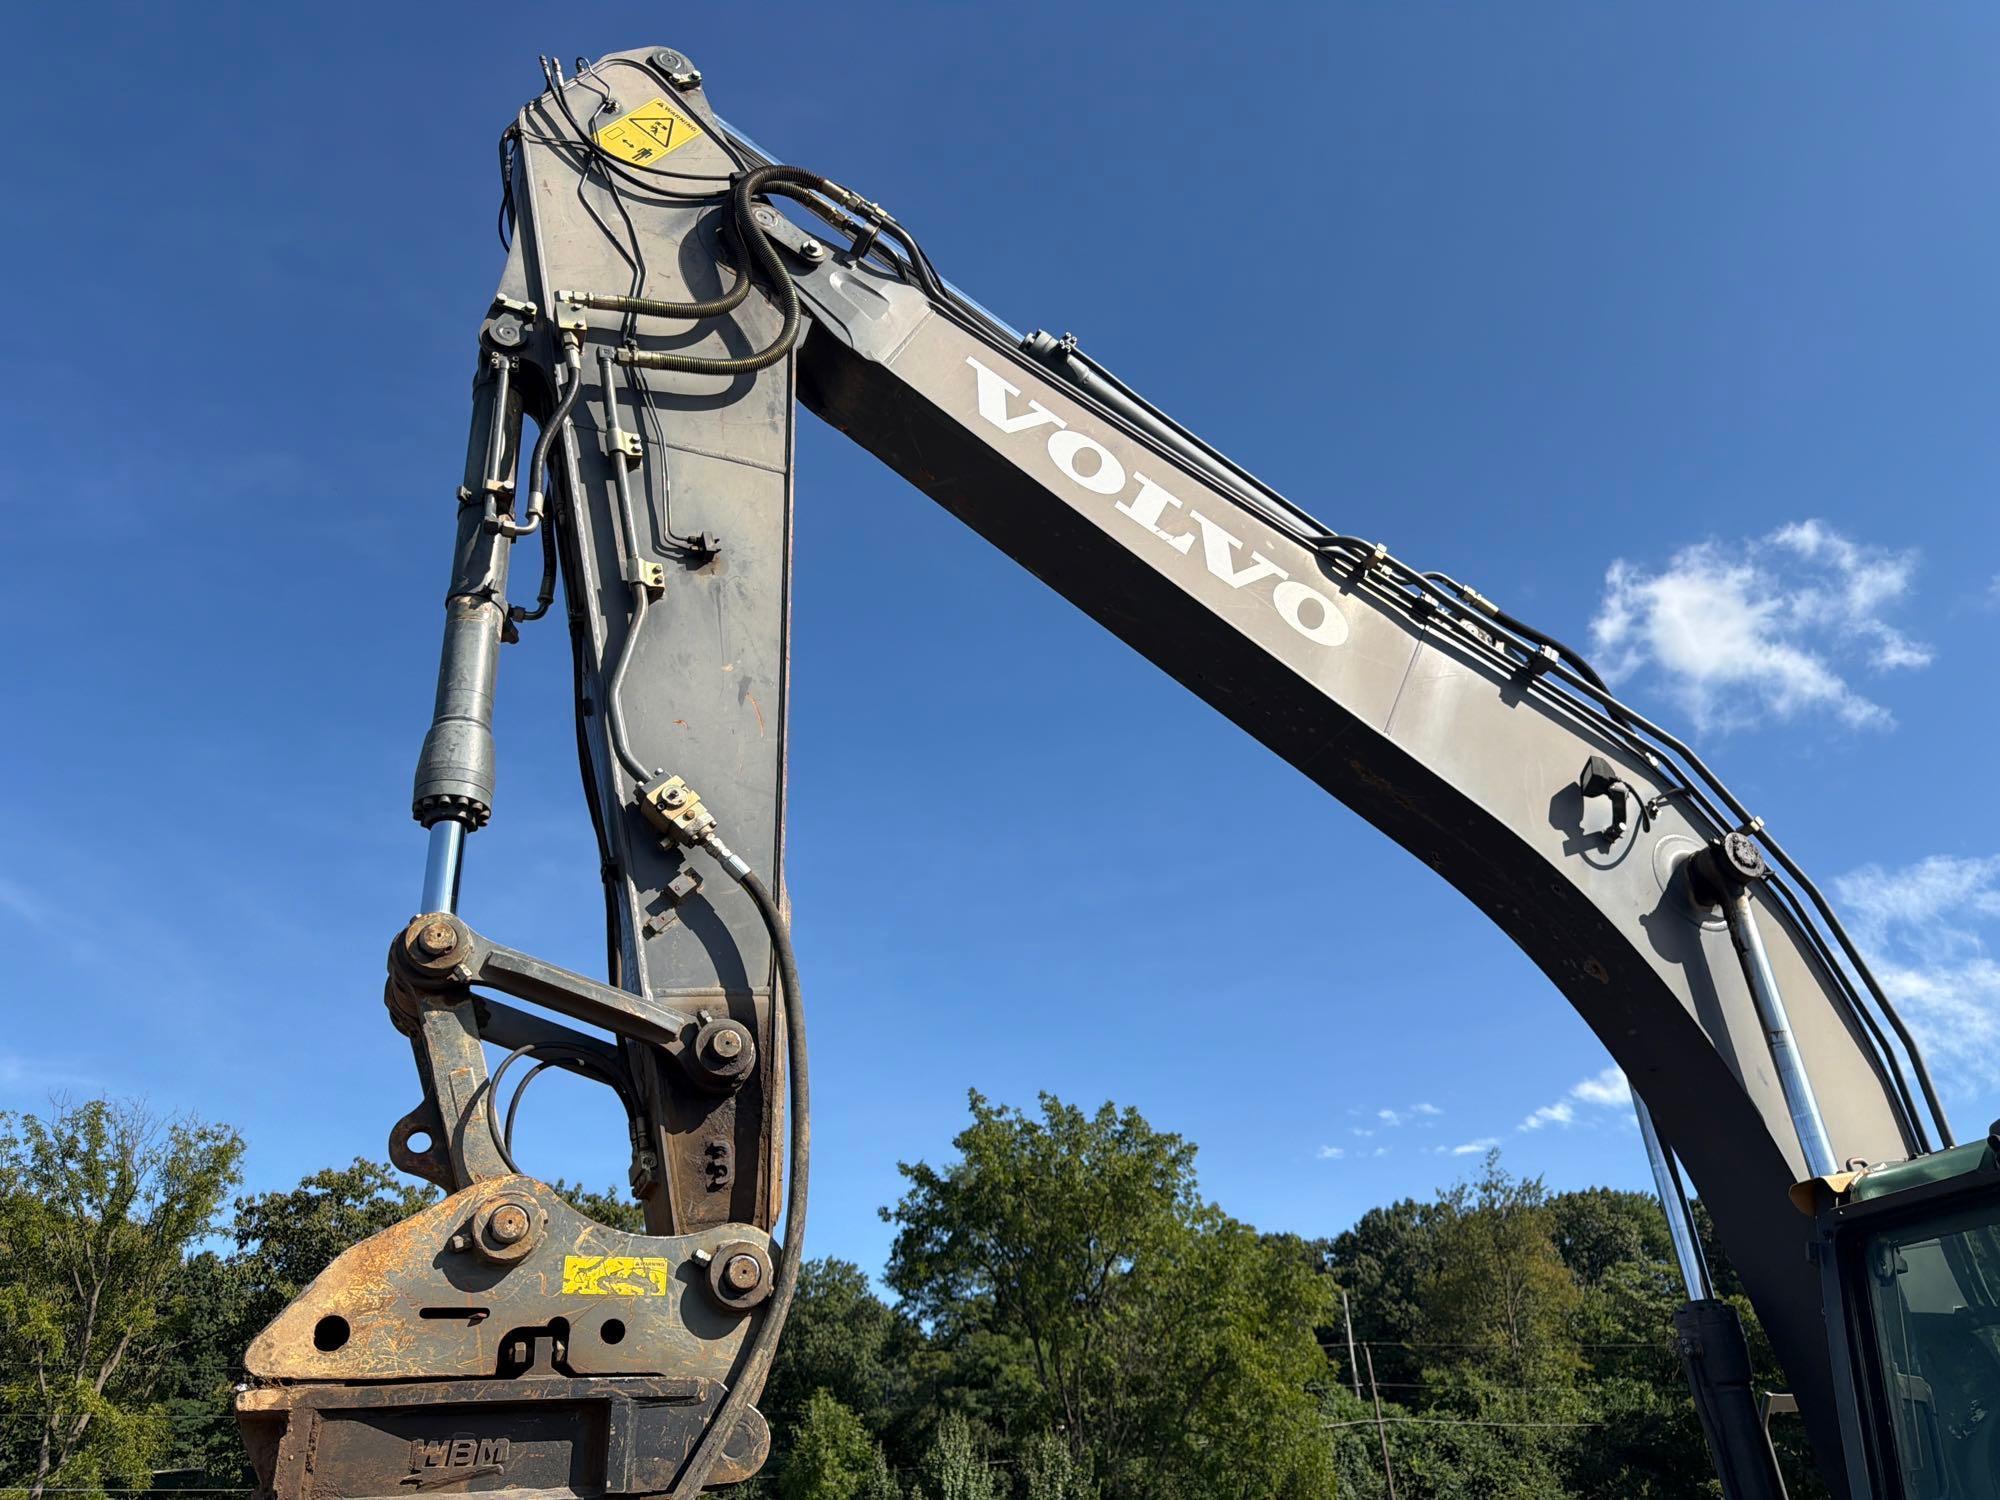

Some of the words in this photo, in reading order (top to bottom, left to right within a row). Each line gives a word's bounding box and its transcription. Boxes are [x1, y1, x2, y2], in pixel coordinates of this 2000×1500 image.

[665, 107, 698, 132] WARNING
[966, 355, 1349, 647] VOLVO
[410, 1437, 510, 1468] WBM
